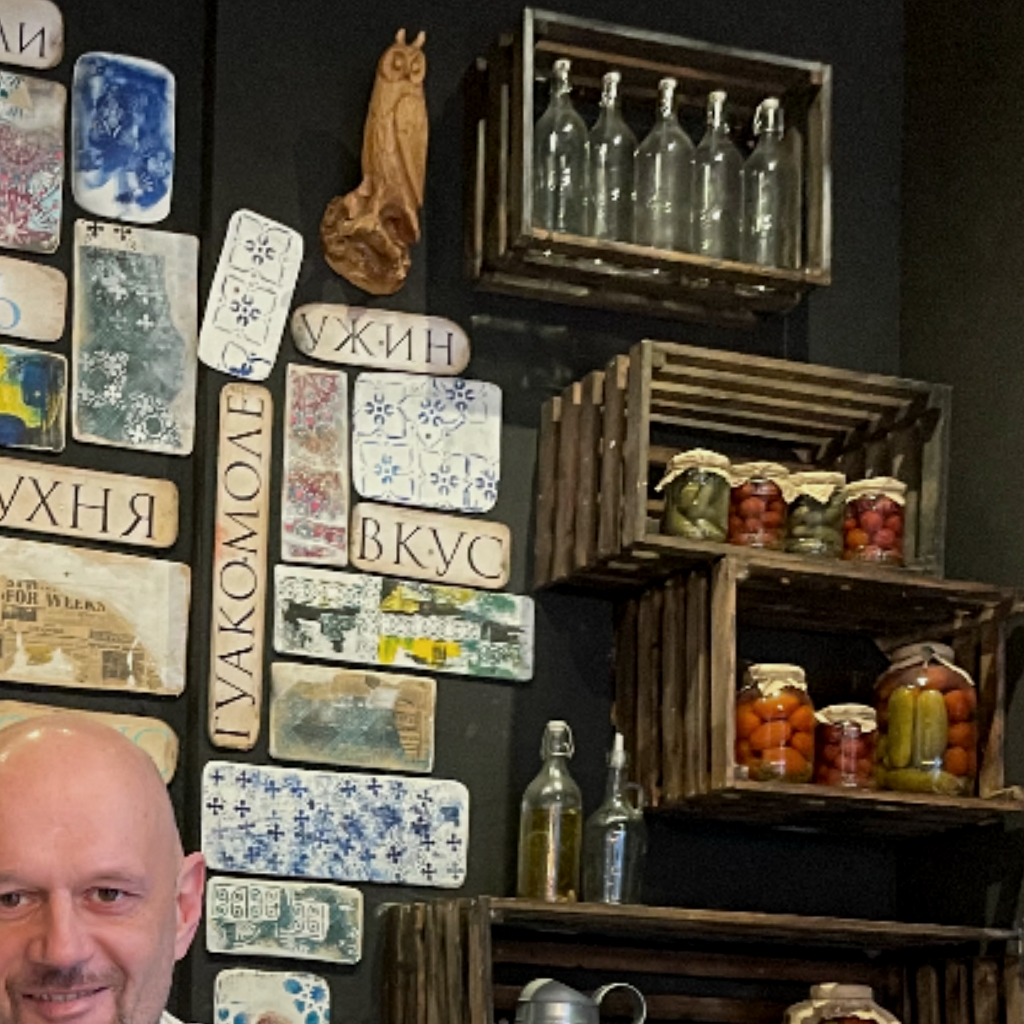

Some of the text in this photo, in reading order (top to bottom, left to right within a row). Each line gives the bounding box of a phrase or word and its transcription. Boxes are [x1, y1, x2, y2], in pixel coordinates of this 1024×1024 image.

[301, 311, 455, 367] УЖИН
[214, 394, 264, 738] ГУАКОМОЛЕ
[357, 516, 504, 580] ВКУС
